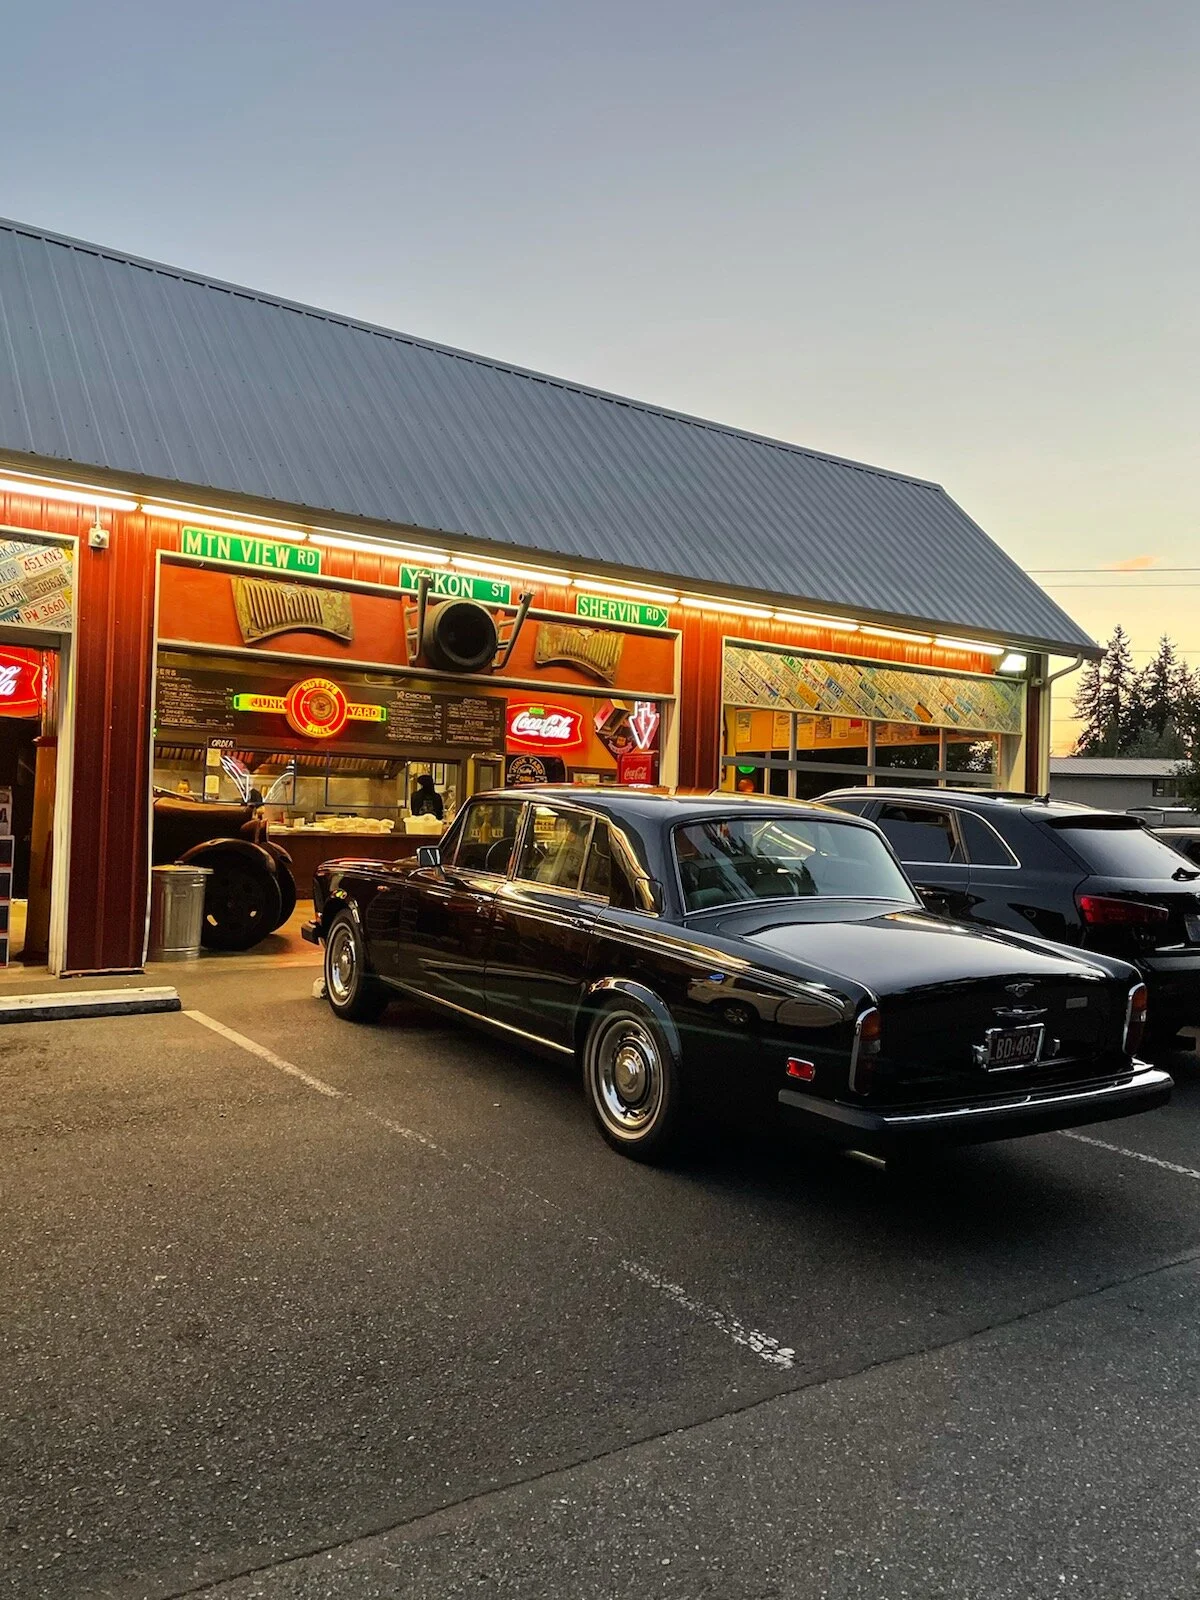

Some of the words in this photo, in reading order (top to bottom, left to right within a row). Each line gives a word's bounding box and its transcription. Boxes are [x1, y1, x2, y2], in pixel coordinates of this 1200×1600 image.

[186, 530, 231, 560] MTN
[240, 540, 290, 569] VIEW
[297, 550, 316, 566] RD
[406, 568, 474, 598] YKON
[491, 583, 506, 598] ST
[40, 599, 66, 616] 3660
[580, 598, 640, 624] SHERVIN
[646, 607, 659, 621] RD
[251, 698, 286, 709] JUNK
[350, 706, 378, 717] YARD
[511, 711, 571, 739] Coca-Cola
[624, 766, 648, 781] Coca-Cola
